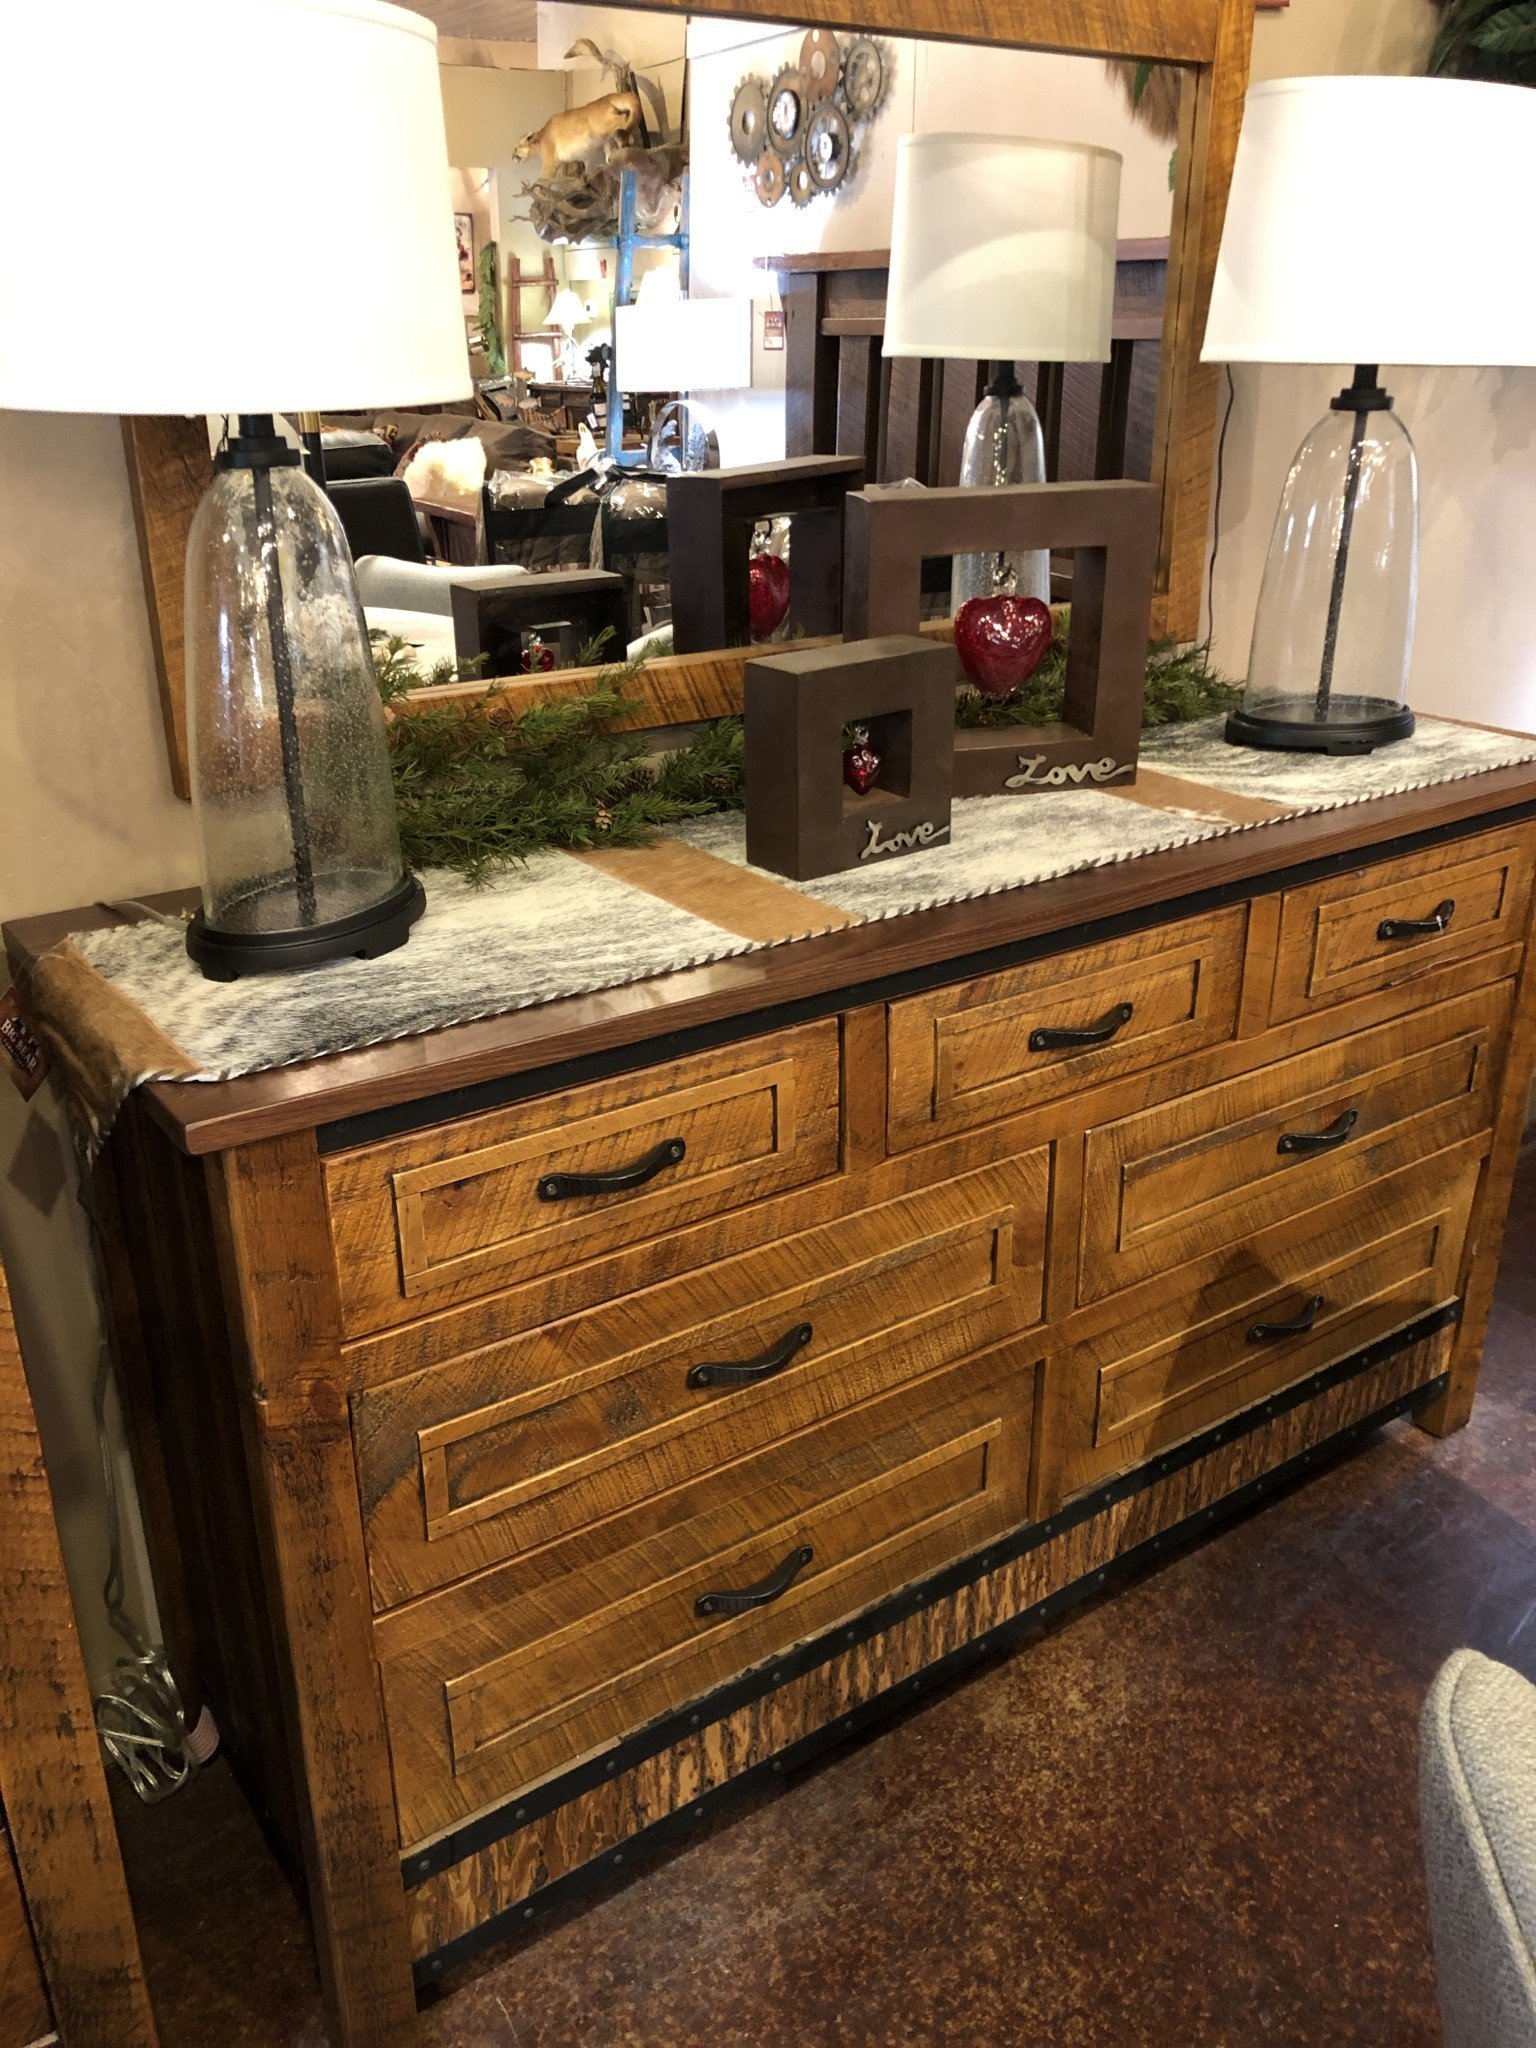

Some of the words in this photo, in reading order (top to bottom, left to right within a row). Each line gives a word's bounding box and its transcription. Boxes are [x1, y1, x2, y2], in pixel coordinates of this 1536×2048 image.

[1004, 753, 1134, 788] Love
[860, 820, 950, 859] Love
[0, 1019, 19, 1043] BIG
